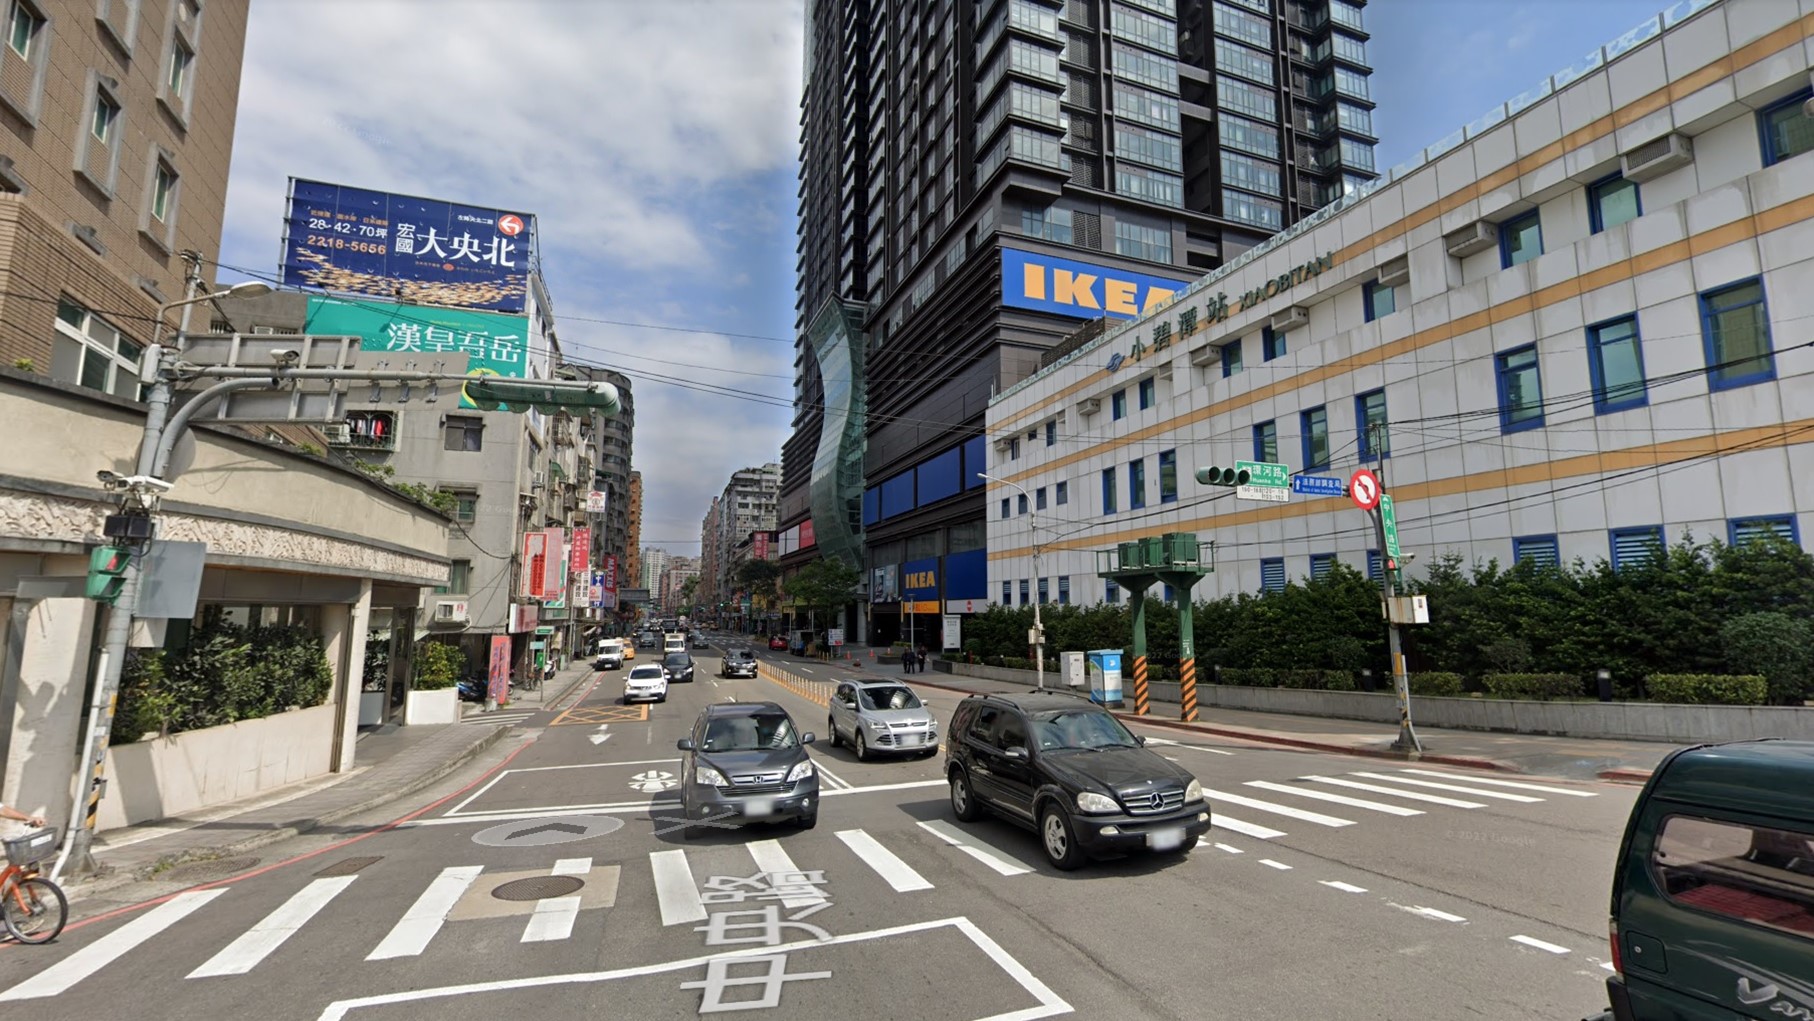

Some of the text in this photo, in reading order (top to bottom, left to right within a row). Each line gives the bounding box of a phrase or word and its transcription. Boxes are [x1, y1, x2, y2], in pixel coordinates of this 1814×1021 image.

[307, 234, 386, 255] 2218-5656
[395, 223, 416, 254] 宏國
[414, 226, 515, 268] 大央北
[1239, 250, 1334, 311] XIAOBITAN
[1130, 291, 1229, 361] 小碧潭站
[1252, 464, 1282, 478] 環河路
[905, 571, 935, 589] IKEA
